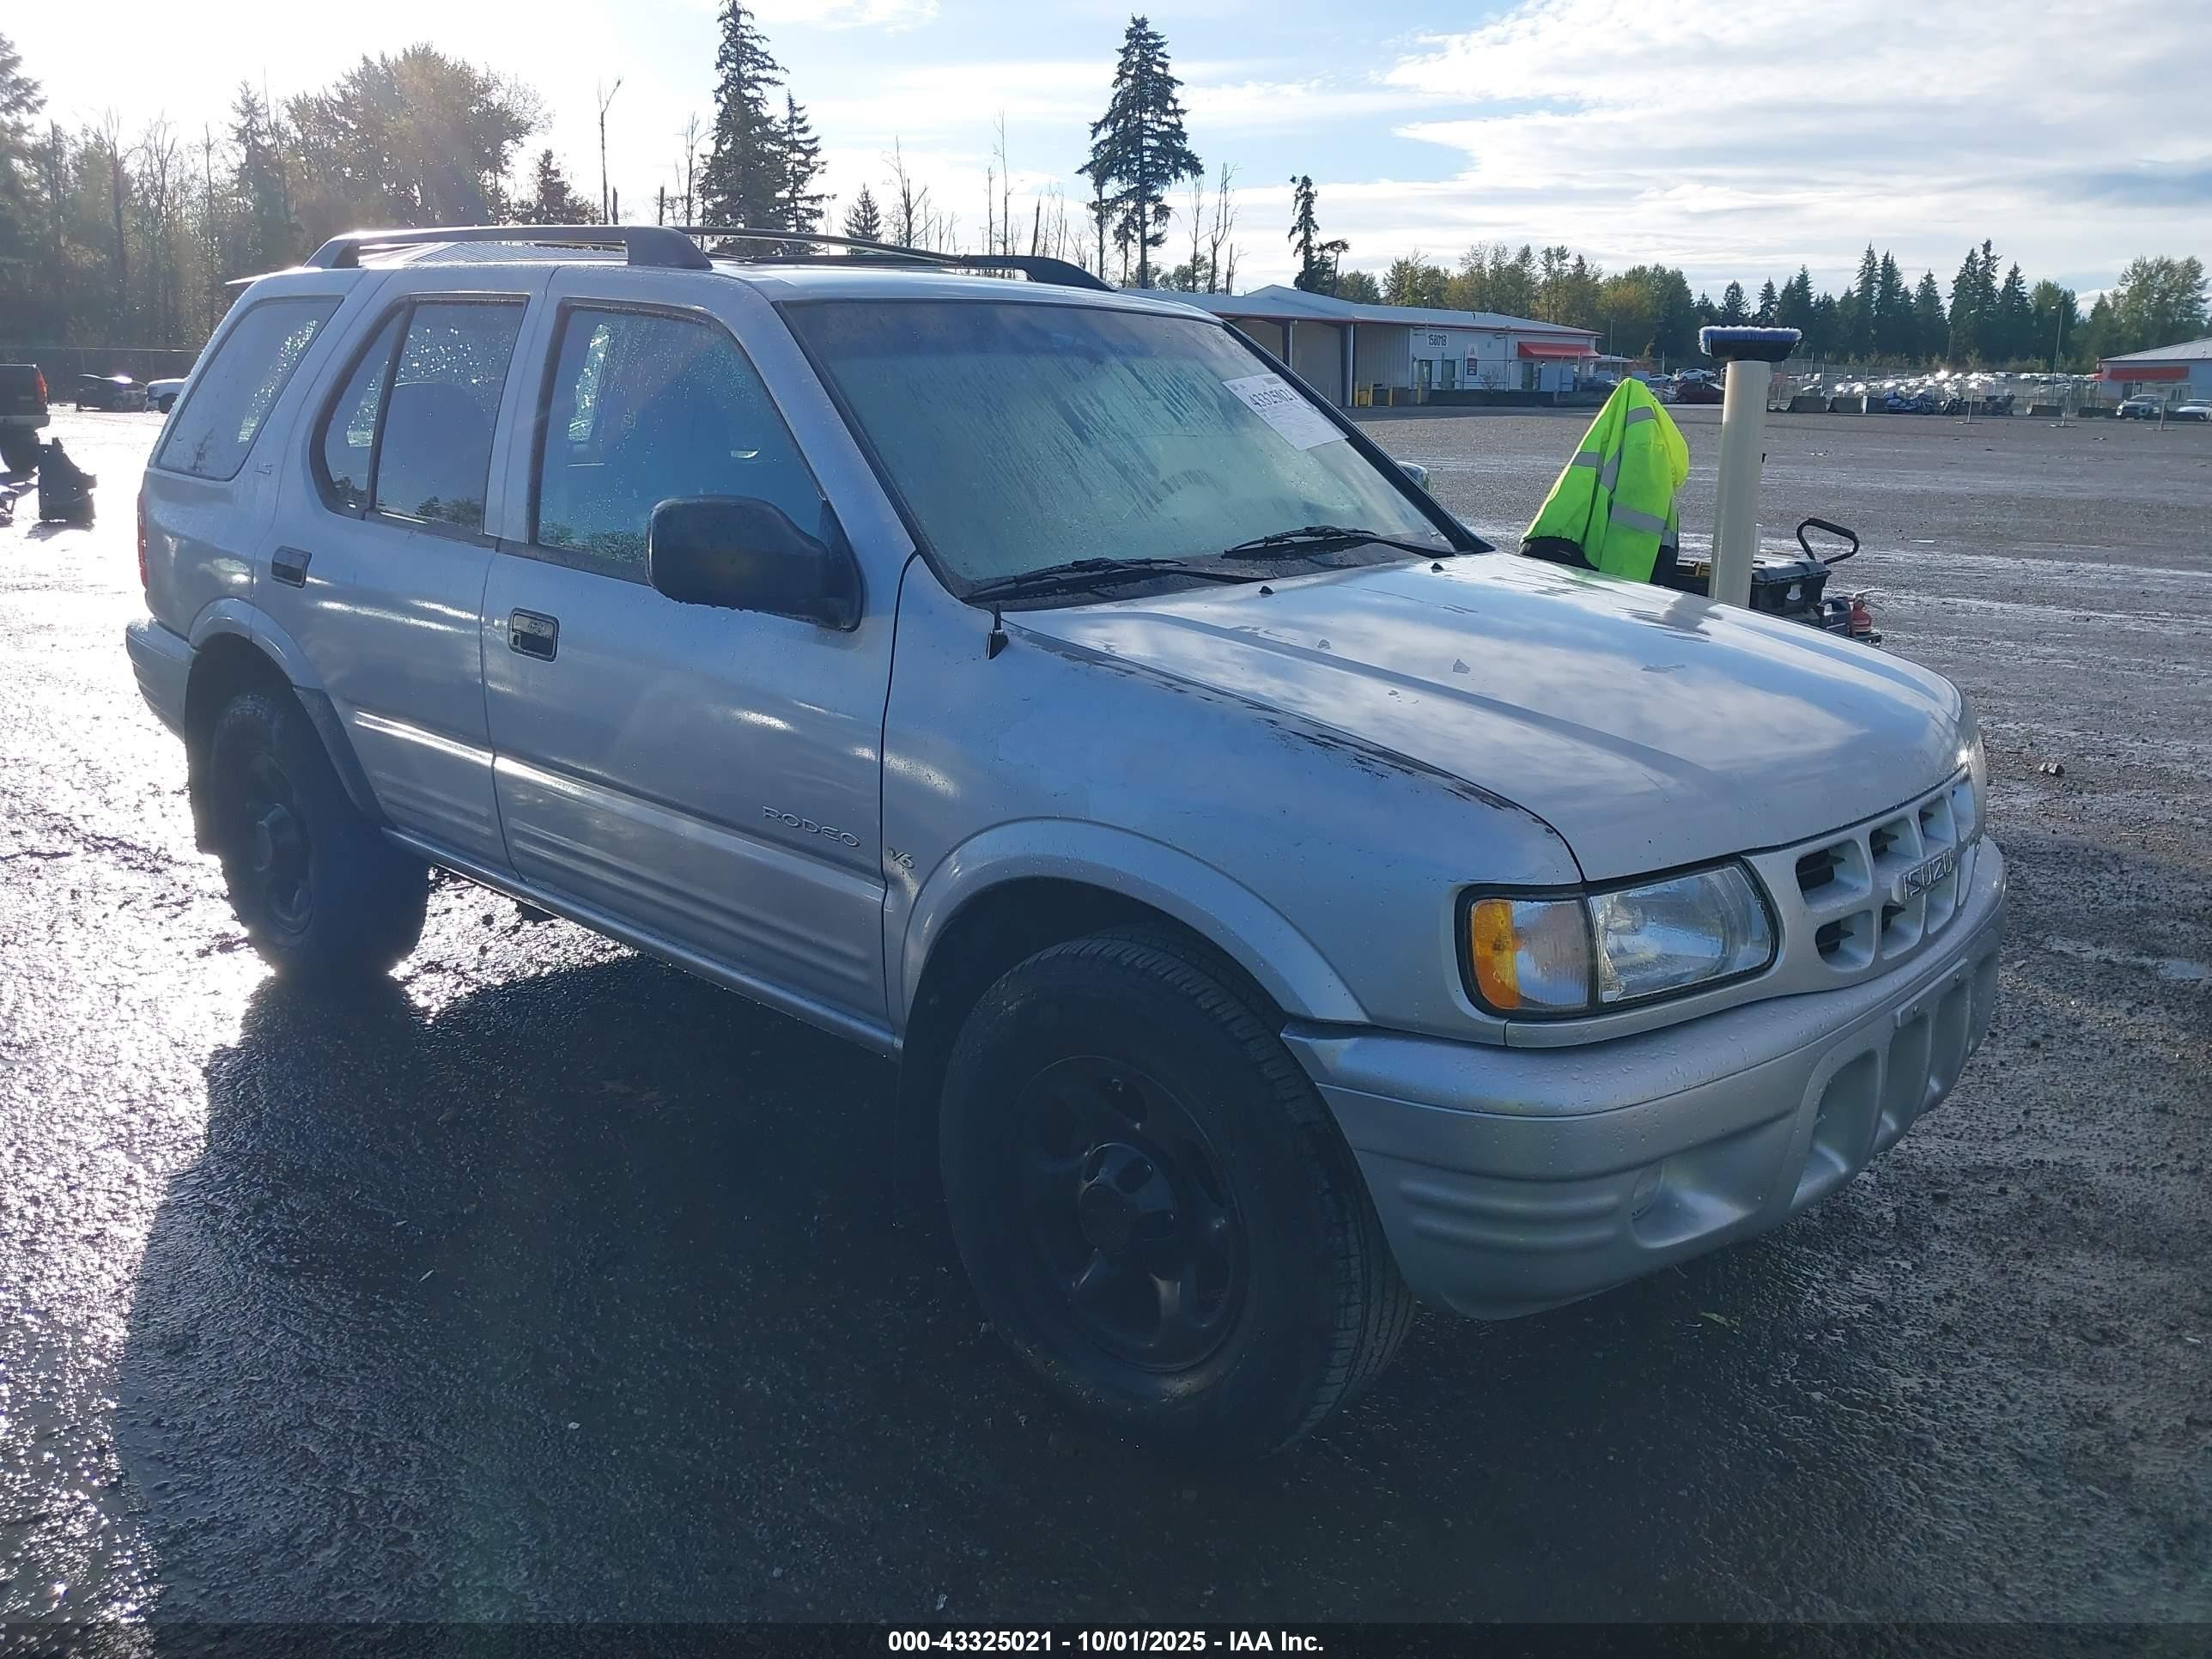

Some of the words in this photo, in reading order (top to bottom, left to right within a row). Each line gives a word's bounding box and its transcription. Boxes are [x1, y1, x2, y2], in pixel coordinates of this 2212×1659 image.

[1249, 388, 1298, 408] 43325021
[762, 805, 860, 848] RODEO
[887, 846, 915, 868] V6
[1902, 848, 1954, 900] ISUZU
